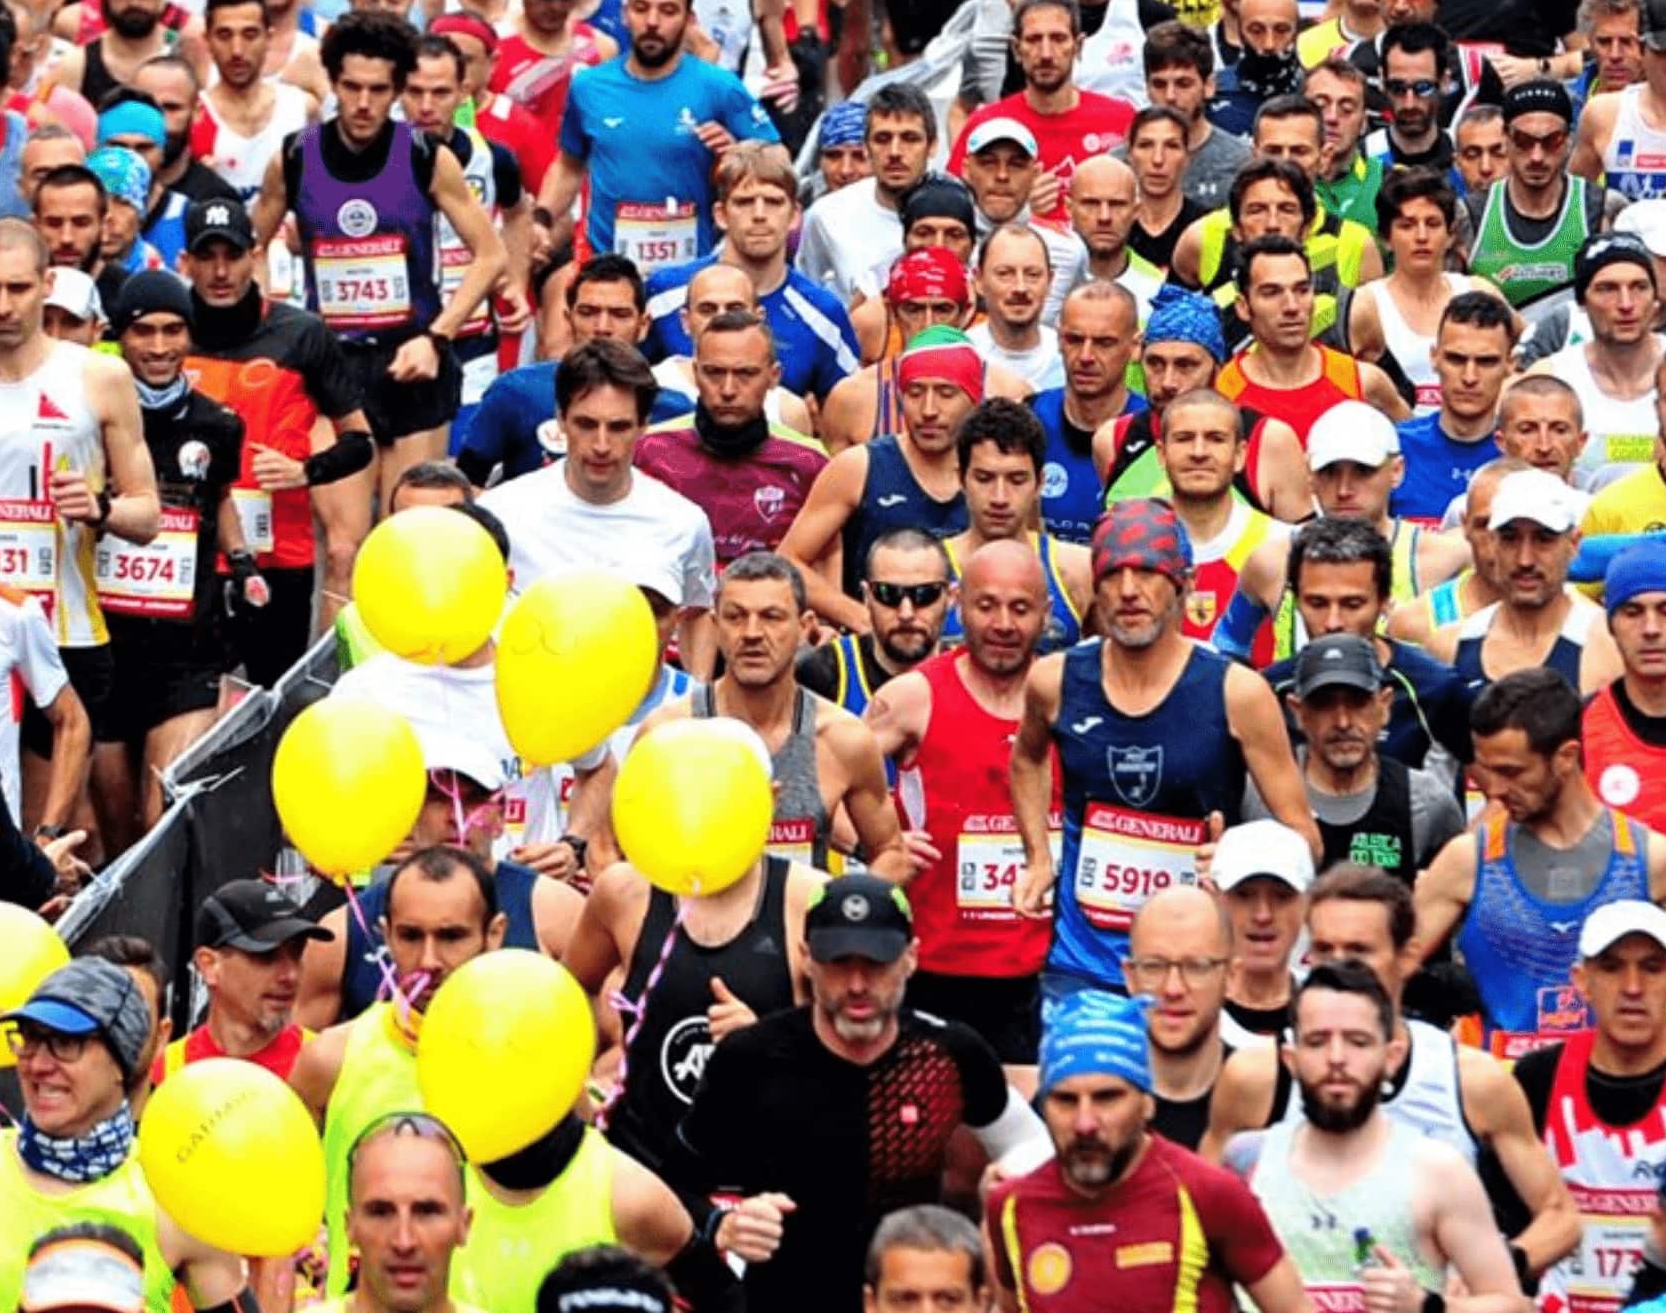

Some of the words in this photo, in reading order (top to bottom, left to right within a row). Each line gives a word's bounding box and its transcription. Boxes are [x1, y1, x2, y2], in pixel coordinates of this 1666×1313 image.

[336, 278, 389, 303] 3743
[114, 553, 175, 584] 3674
[1117, 813, 1203, 844] GENERALI
